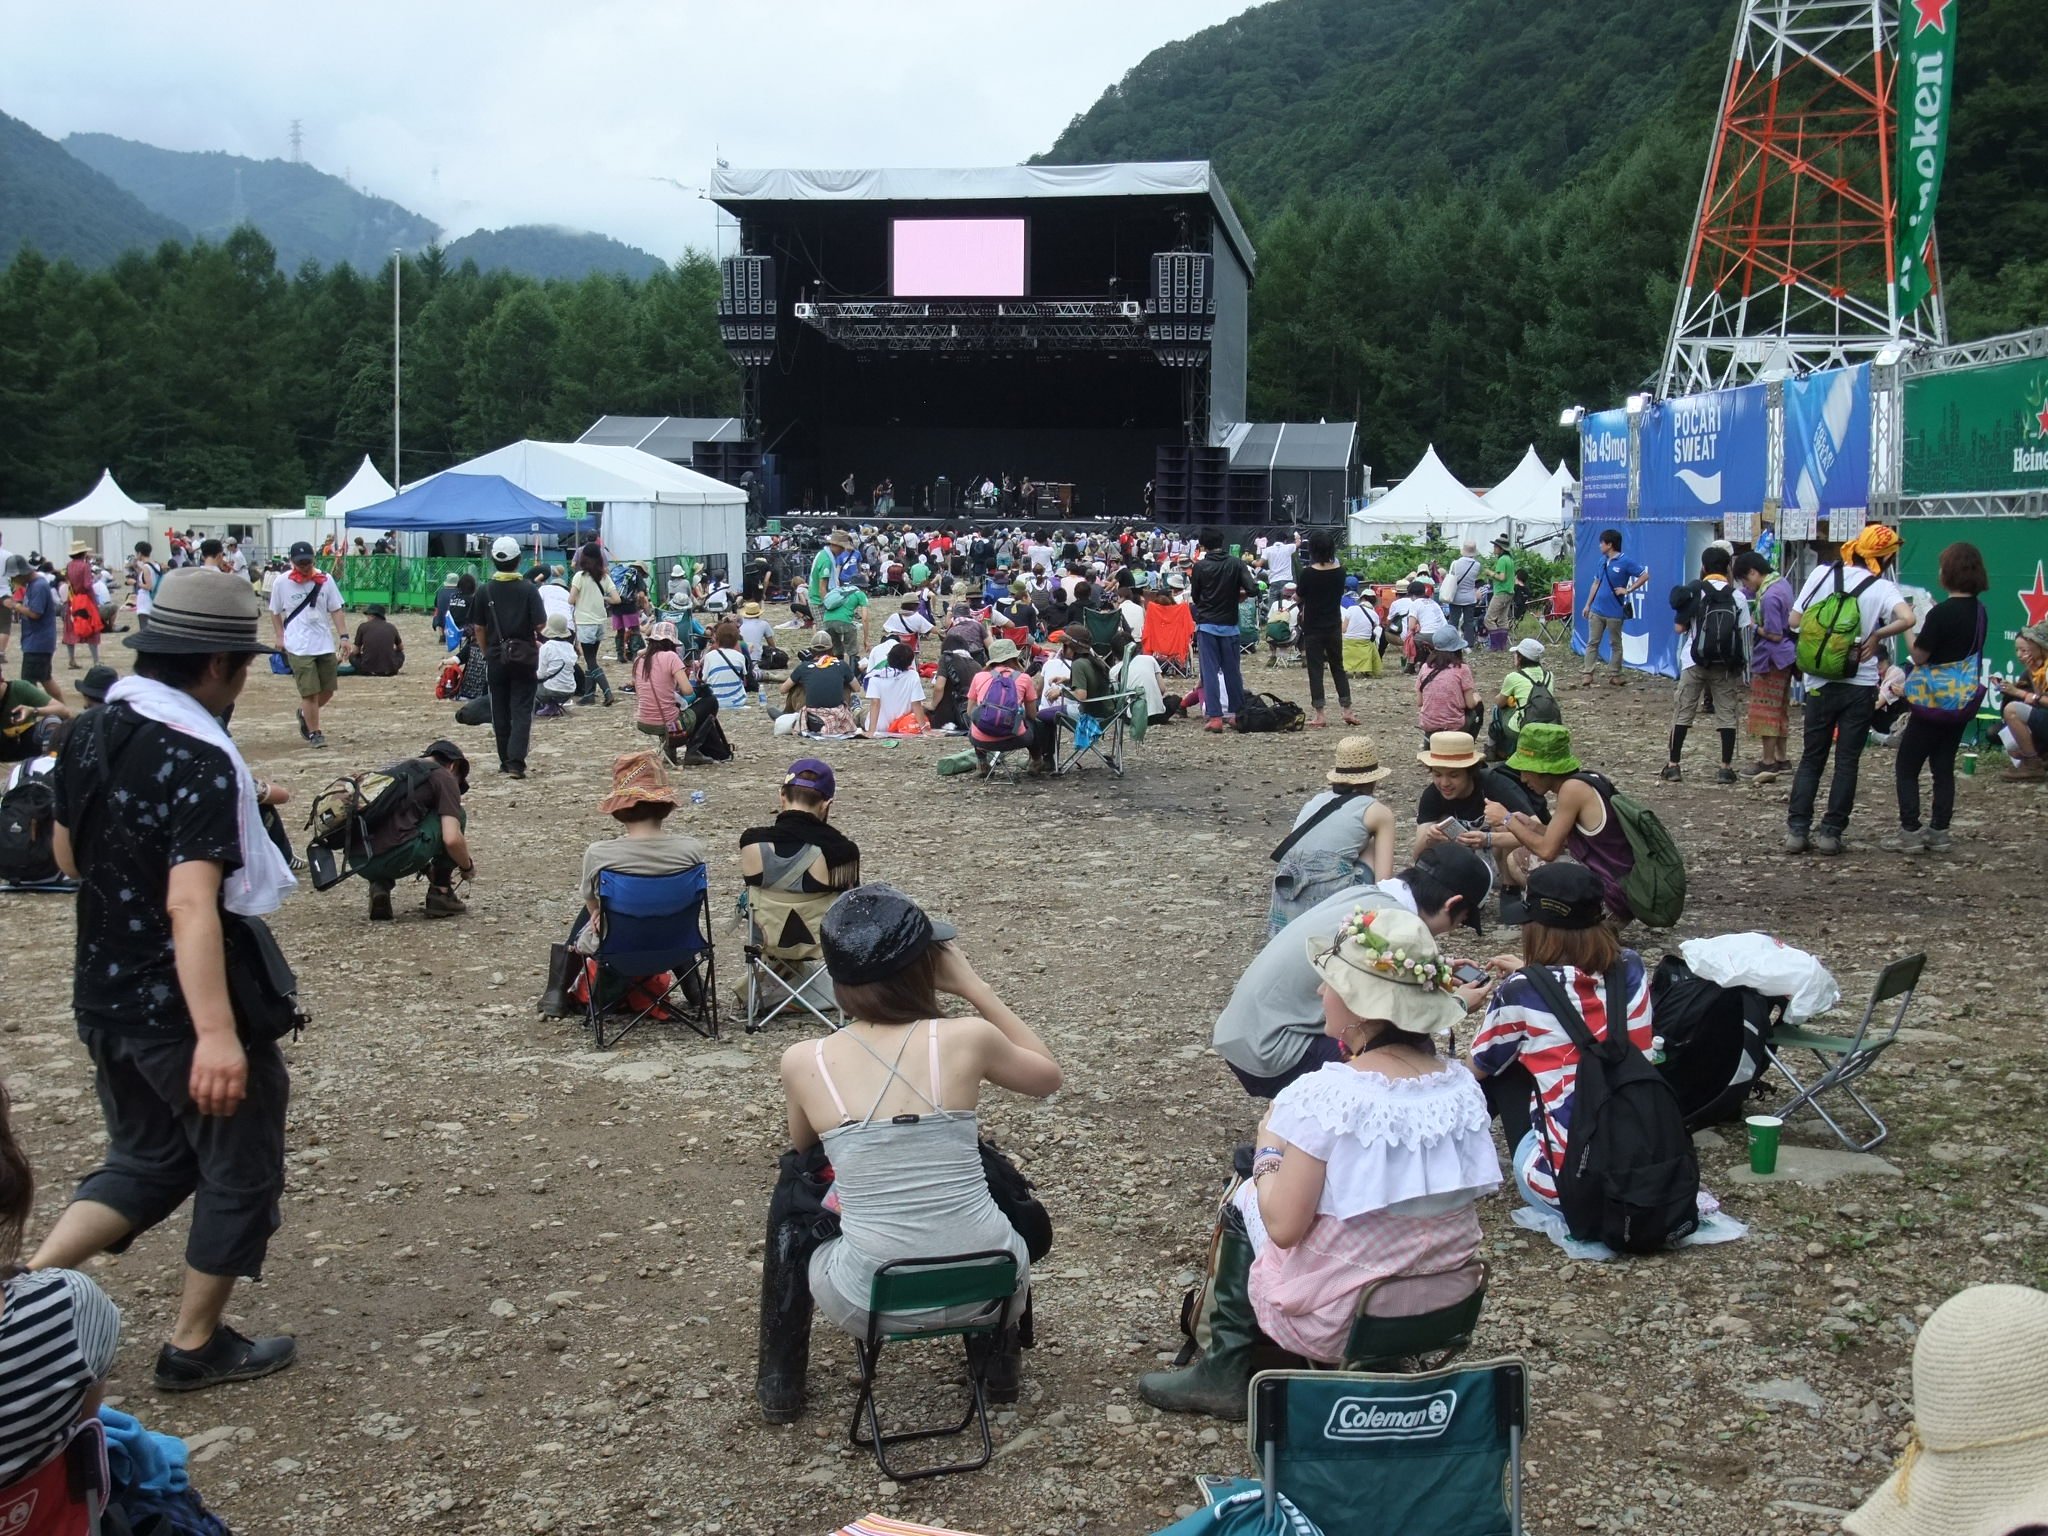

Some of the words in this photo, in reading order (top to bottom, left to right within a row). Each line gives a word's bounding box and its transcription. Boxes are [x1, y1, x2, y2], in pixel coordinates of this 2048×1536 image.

[1674, 406, 1721, 437] POCARI
[1599, 432, 1627, 468] 49mg
[1674, 434, 1717, 464] SWEAT
[1339, 1403, 1427, 1430] Coleman
